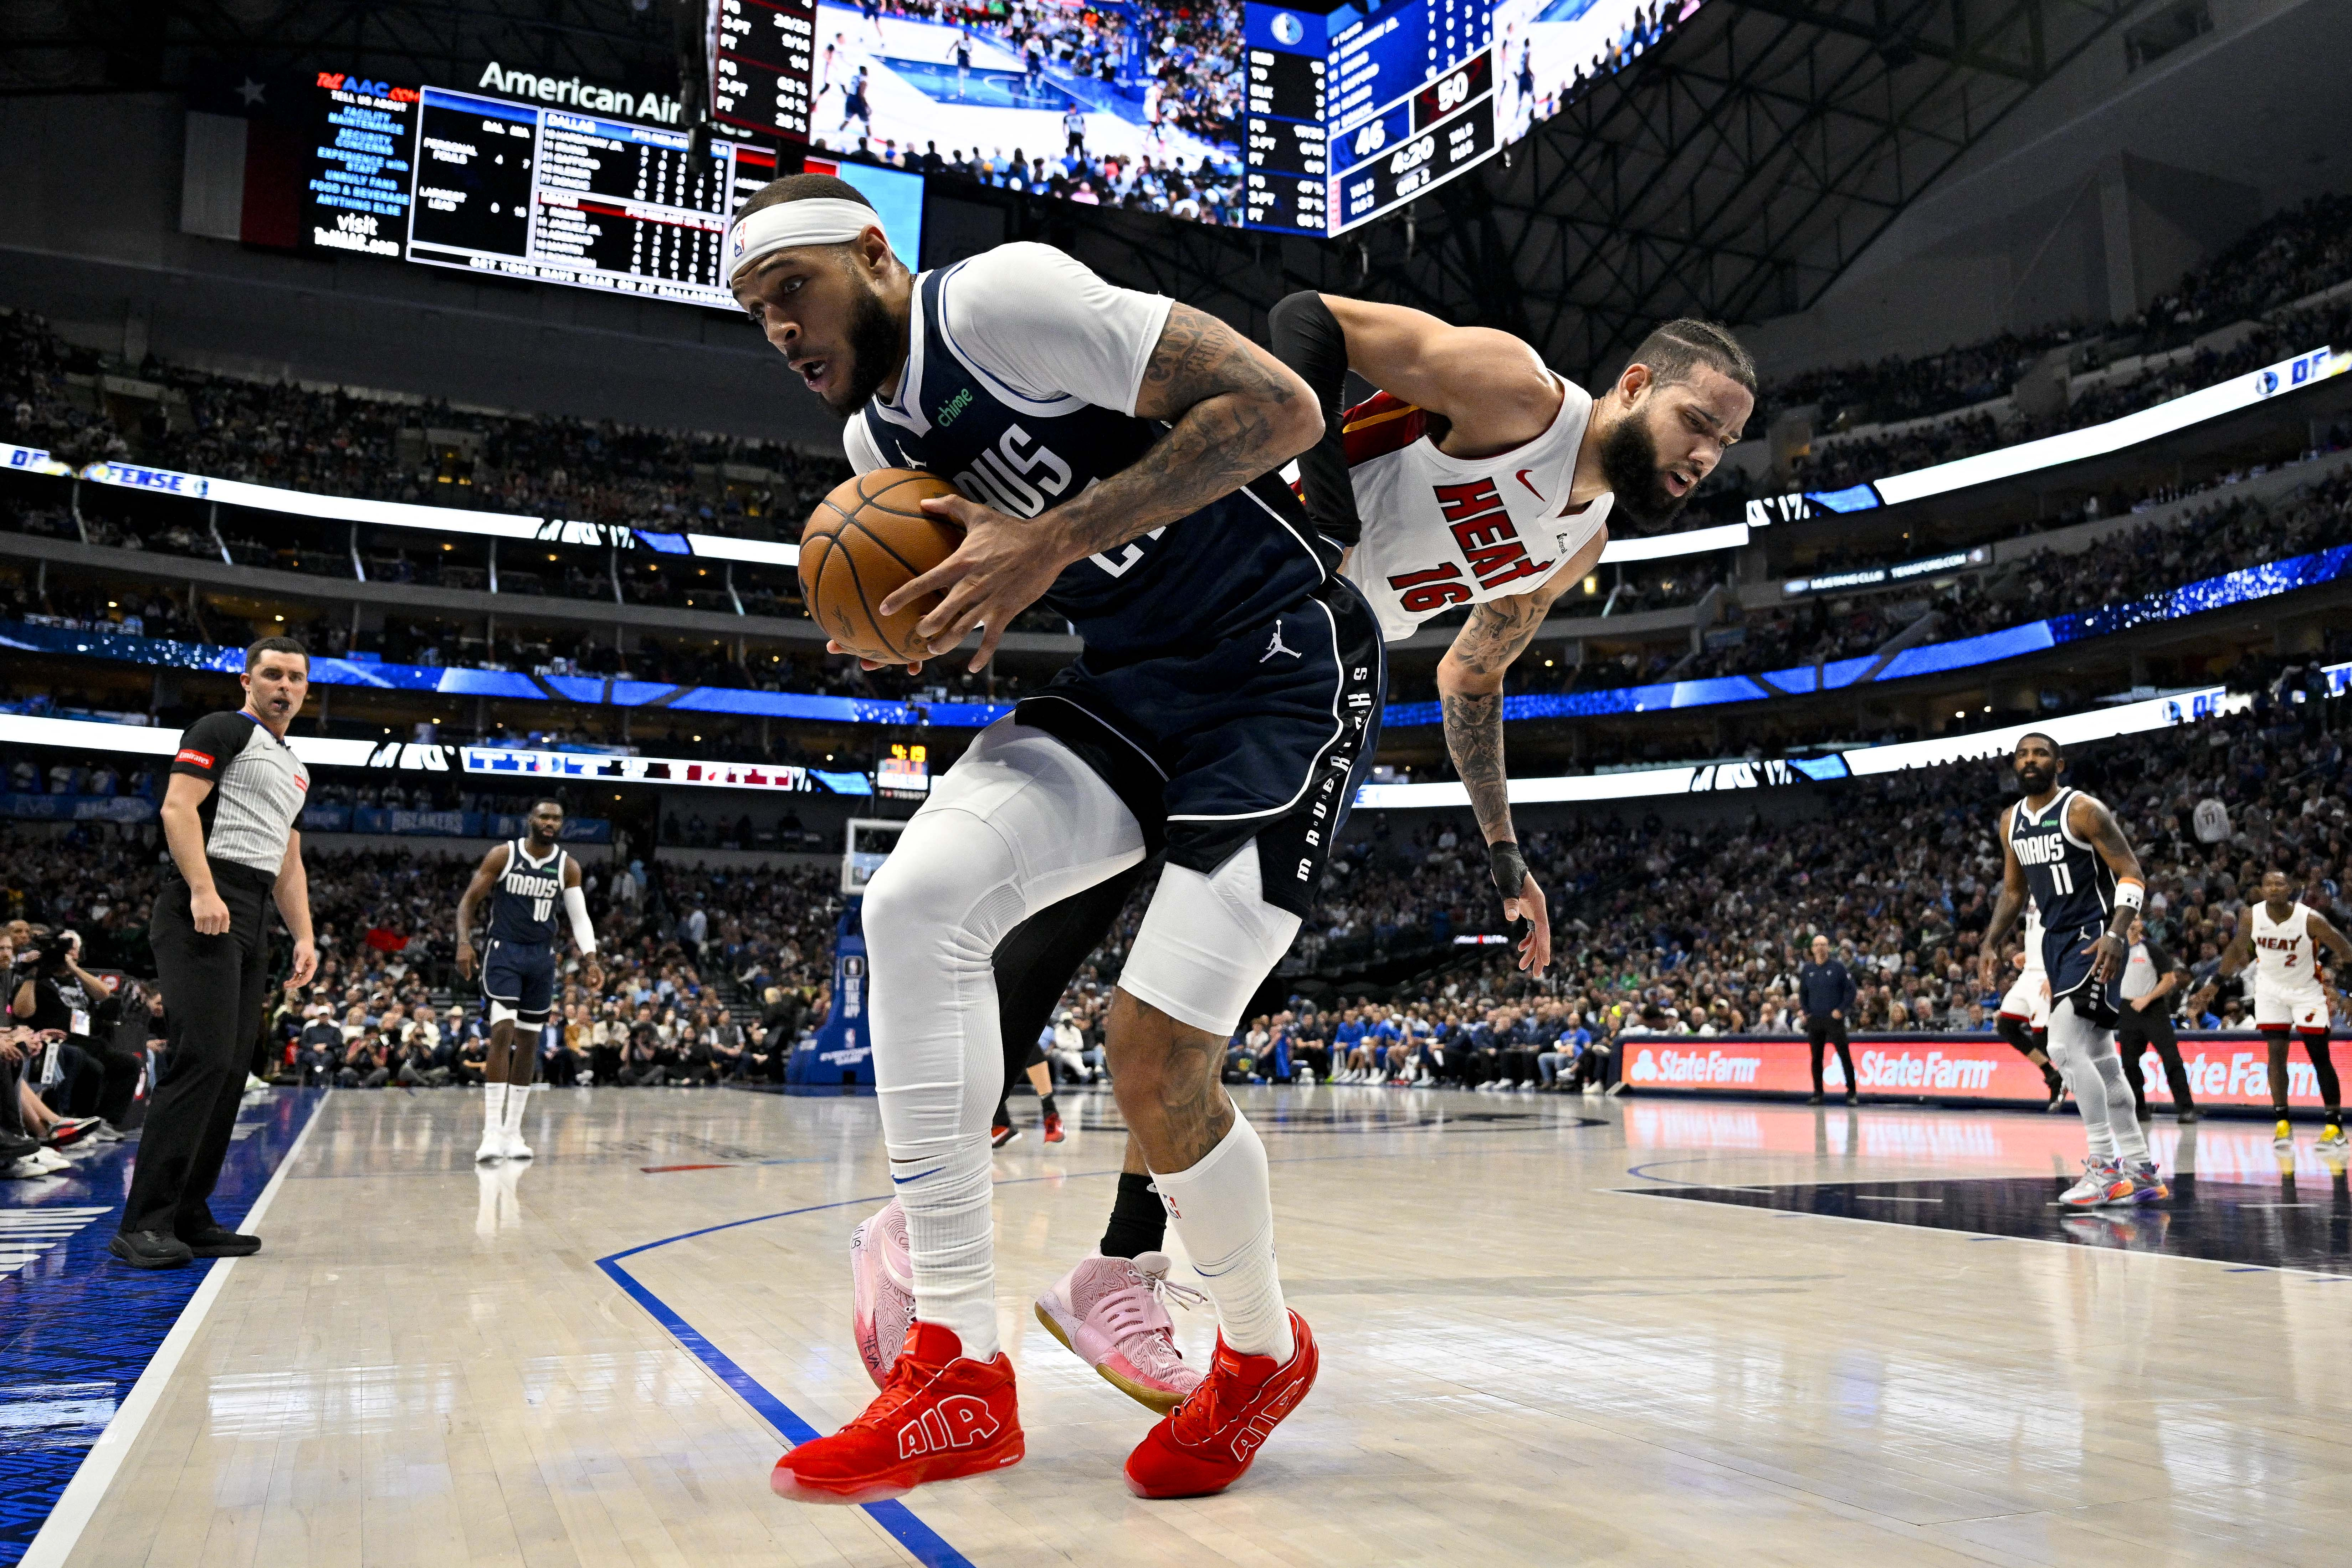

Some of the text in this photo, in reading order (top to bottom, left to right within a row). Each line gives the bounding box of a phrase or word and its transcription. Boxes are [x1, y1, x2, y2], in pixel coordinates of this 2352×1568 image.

[479, 61, 634, 115] American
[547, 113, 596, 133] DALLAS
[1355, 72, 1469, 155] 46 50
[1390, 135, 1435, 174] 4:20
[309, 179, 340, 194] FOOD
[353, 186, 410, 205] BEVERAGE
[317, 193, 401, 216] ANYTHING ELSE
[337, 213, 378, 235] Visit
[470, 257, 497, 270] GET
[500, 262, 536, 276] YOUR
[540, 268, 575, 282] MAVS
[578, 273, 614, 288] GEAR
[938, 387, 973, 427] chime
[1433, 476, 1556, 591] HEAT
[1387, 562, 1474, 613] 16
[179, 752, 209, 765] Emirates
[892, 744, 926, 762] 4:19
[2013, 832, 2064, 866] MAVS
[506, 872, 558, 898] MAVS
[2049, 862, 2074, 895] 11
[533, 898, 553, 922] 10
[2256, 935, 2302, 952] HEAT
[2285, 954, 2298, 967] 2
[898, 1394, 999, 1459] AIR
[1230, 1377, 1305, 1462] AIR
